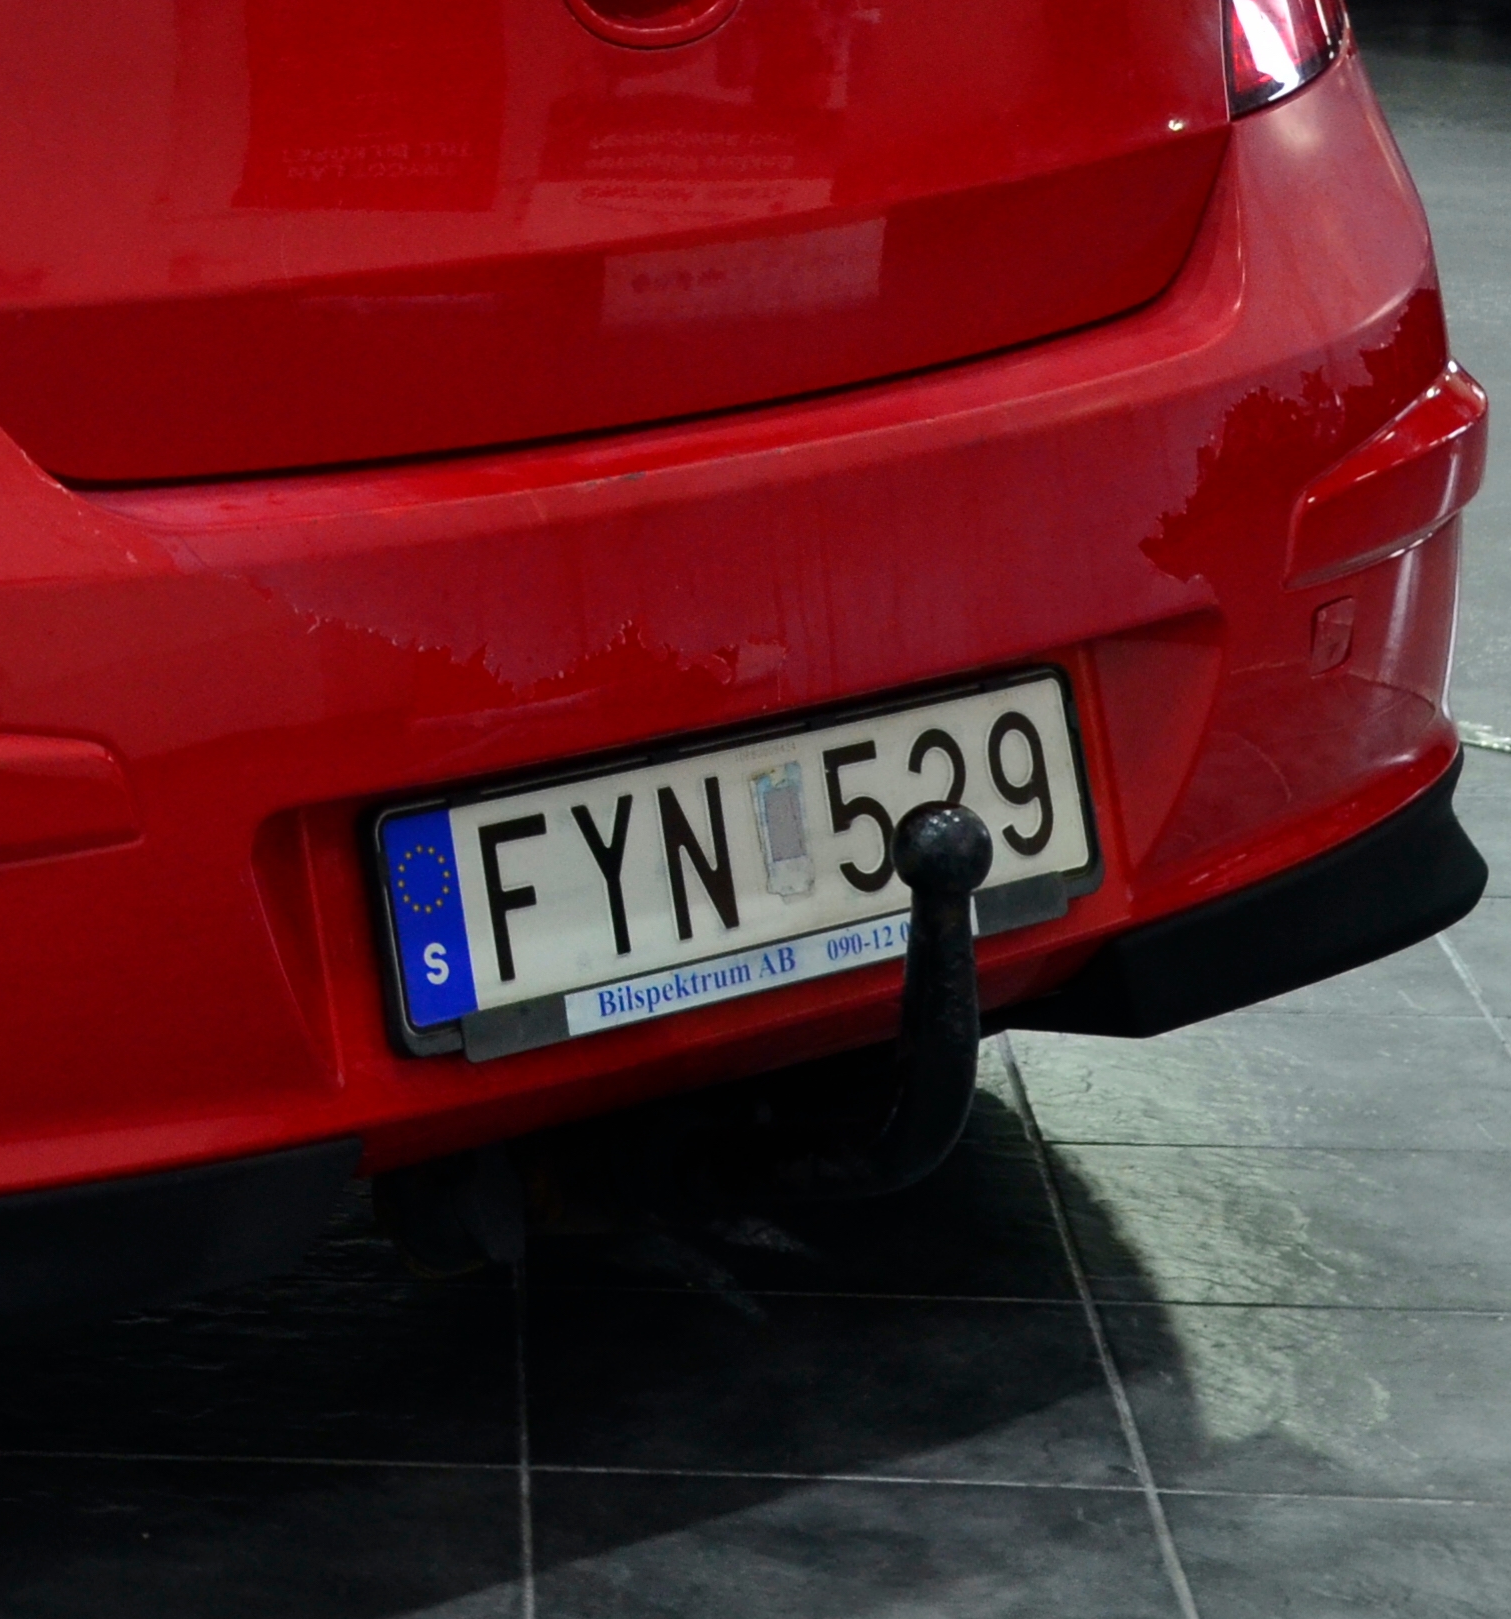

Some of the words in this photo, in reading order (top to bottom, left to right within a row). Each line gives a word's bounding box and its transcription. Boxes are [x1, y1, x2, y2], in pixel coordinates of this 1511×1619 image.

[477, 776, 740, 983] FYN
[423, 942, 451, 986] S
[597, 960, 752, 1018] Bilspektrum
[758, 946, 797, 979] AB
[826, 924, 894, 960] 090-12
